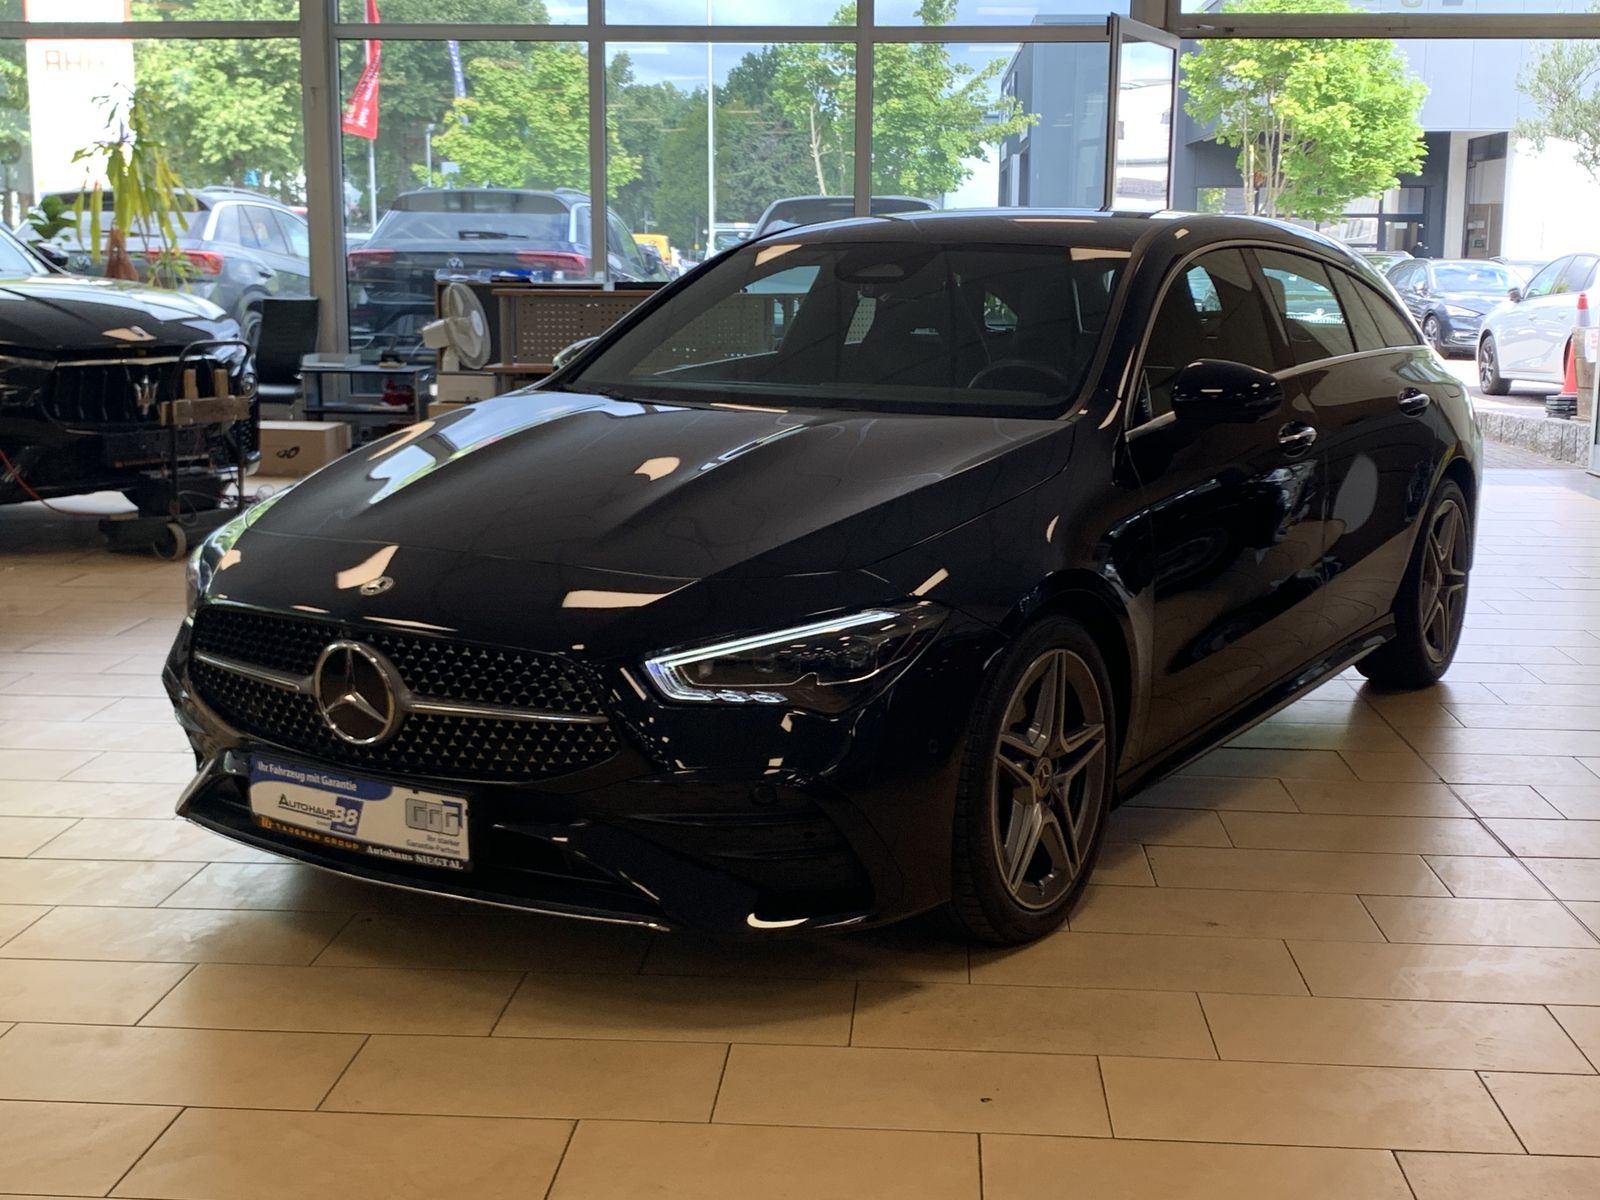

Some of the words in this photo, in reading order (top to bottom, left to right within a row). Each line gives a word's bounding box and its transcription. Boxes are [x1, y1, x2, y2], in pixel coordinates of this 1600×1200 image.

[257, 760, 269, 772] Ihr
[269, 764, 306, 783] Fahrzeug
[307, 772, 321, 784] mit
[321, 776, 357, 791] Garantie
[332, 804, 359, 826] 38
[366, 845, 413, 862] Autohaus
[415, 853, 464, 870] SIEGTAL
